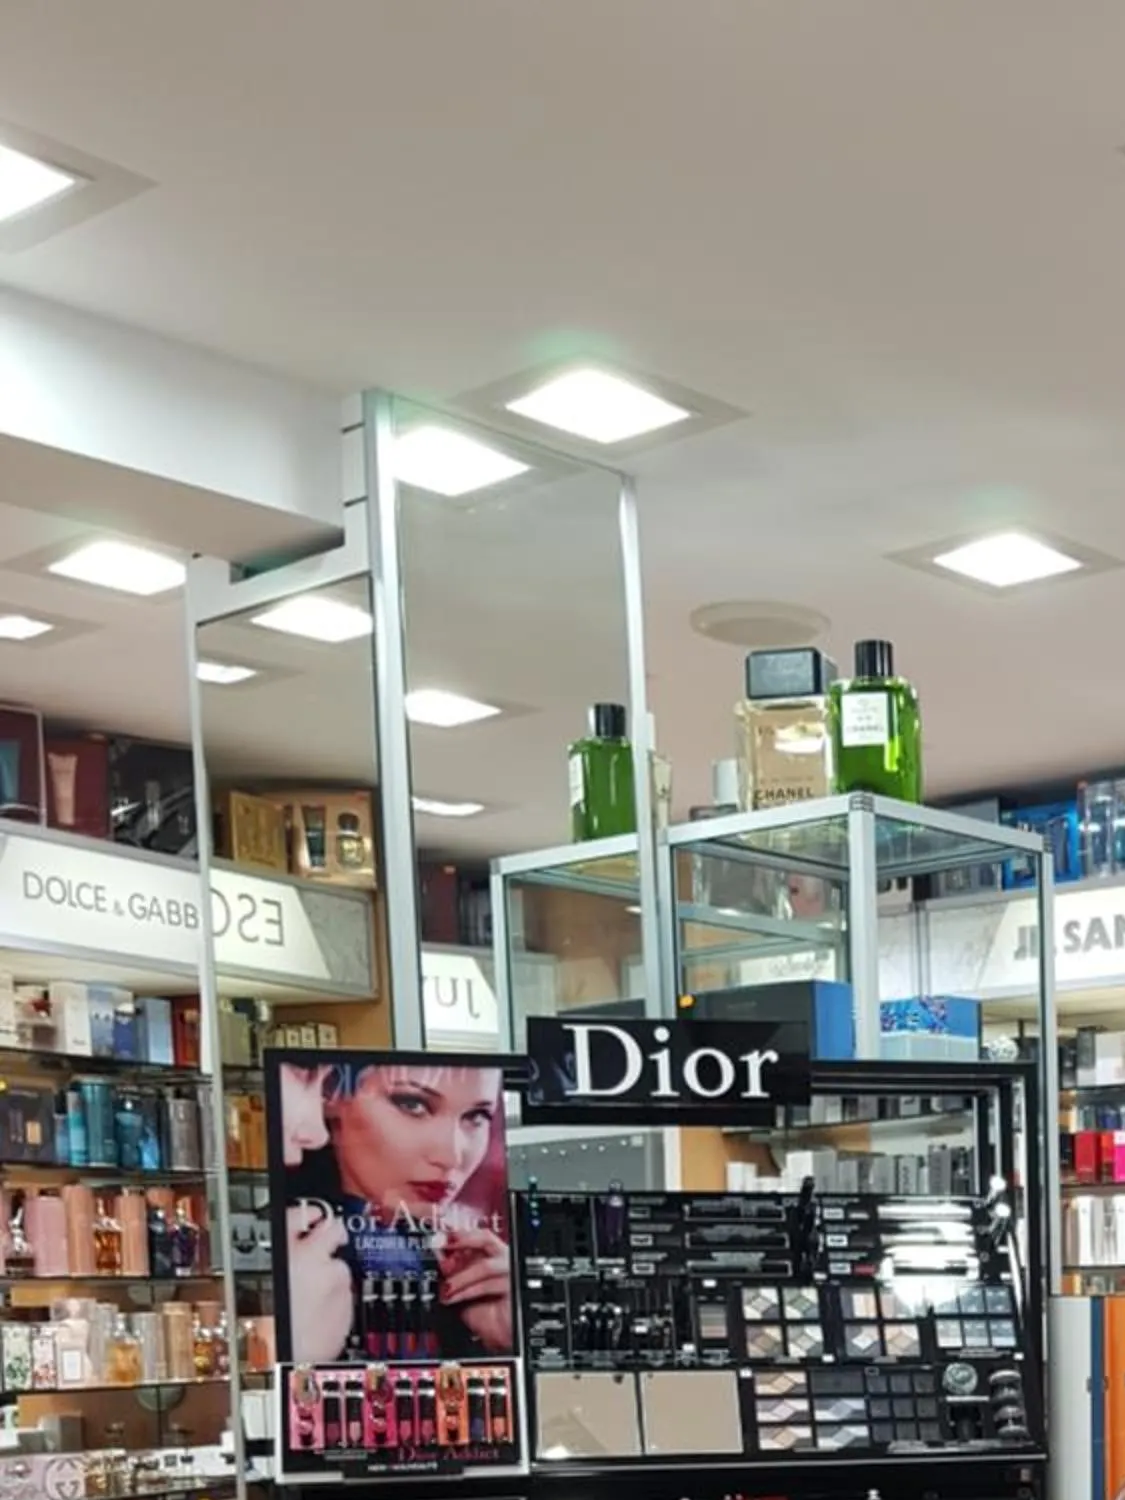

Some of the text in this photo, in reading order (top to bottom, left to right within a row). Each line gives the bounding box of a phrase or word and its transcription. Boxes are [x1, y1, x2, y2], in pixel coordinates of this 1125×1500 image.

[754, 785, 814, 802] CHANEL
[23, 870, 107, 912] DOLCE
[562, 1024, 779, 1098] Dior
[295, 1197, 504, 1233] Dior Addict
